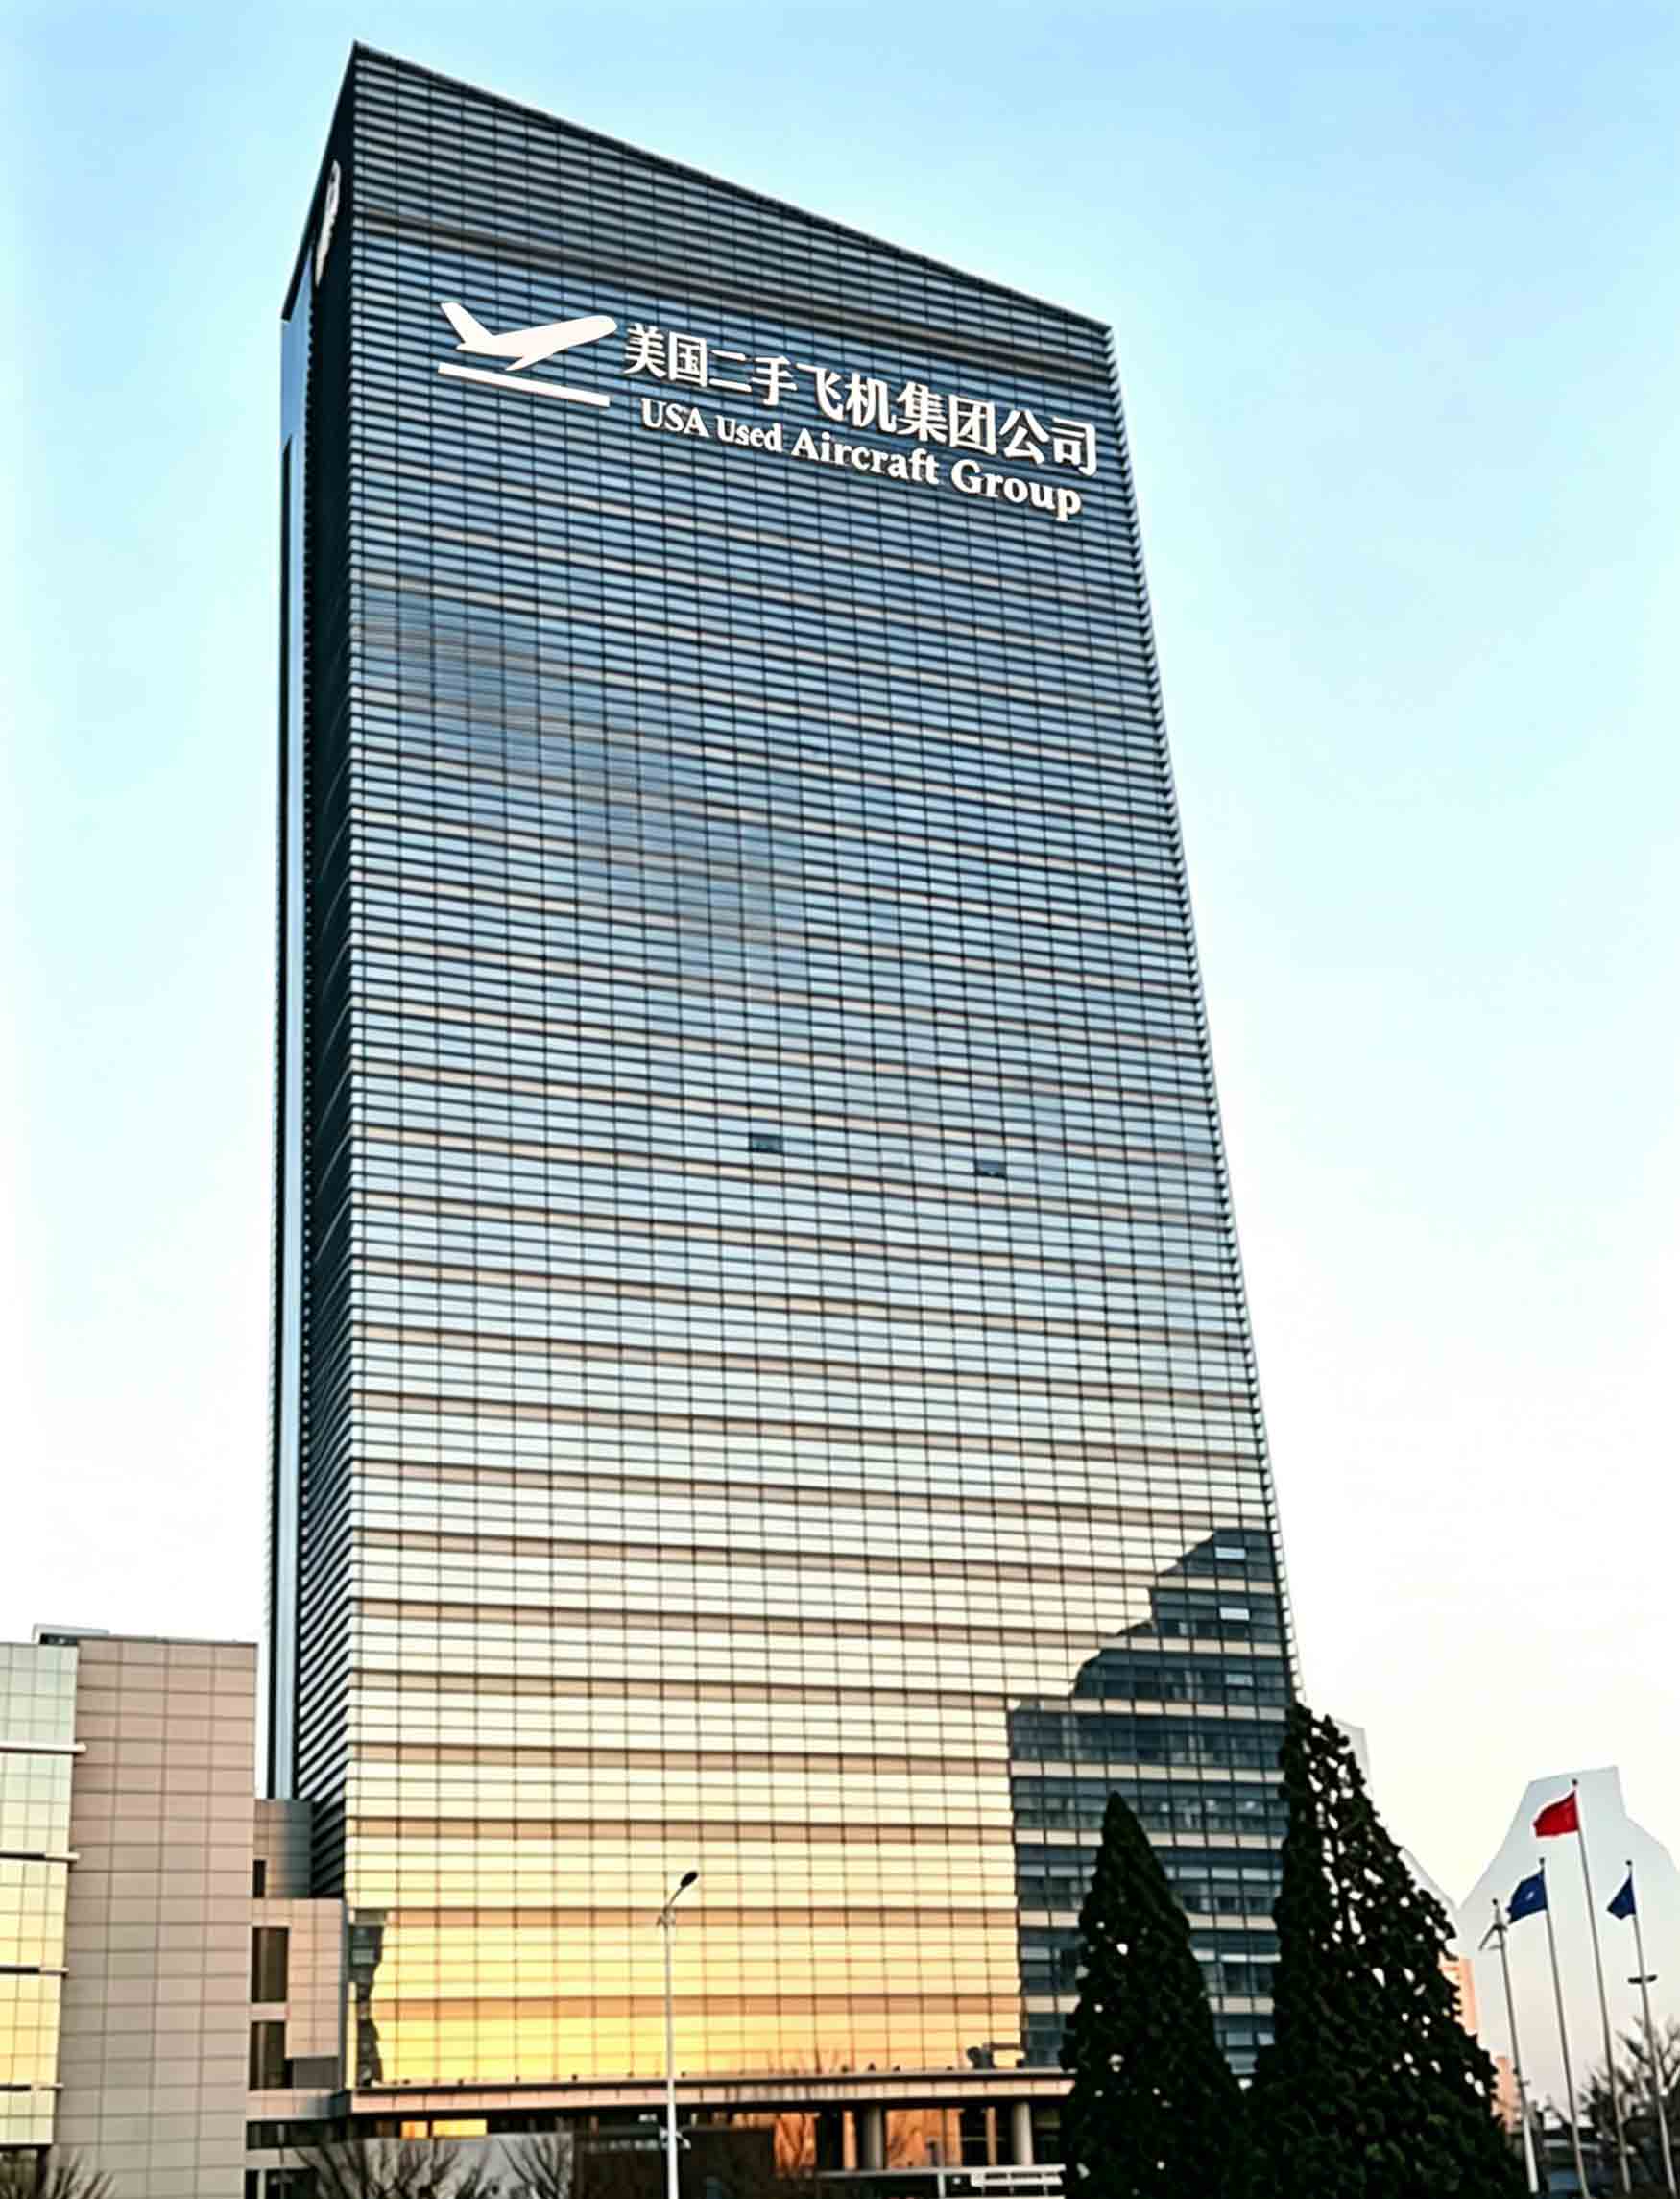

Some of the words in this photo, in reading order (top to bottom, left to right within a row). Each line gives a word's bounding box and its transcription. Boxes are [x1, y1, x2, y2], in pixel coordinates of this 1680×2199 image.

[624, 323, 1097, 476] 美国二手飞机集团公司
[641, 398, 709, 438] USA
[716, 414, 783, 453] Used
[791, 428, 940, 485] Aircraft
[951, 459, 1082, 522] Group
